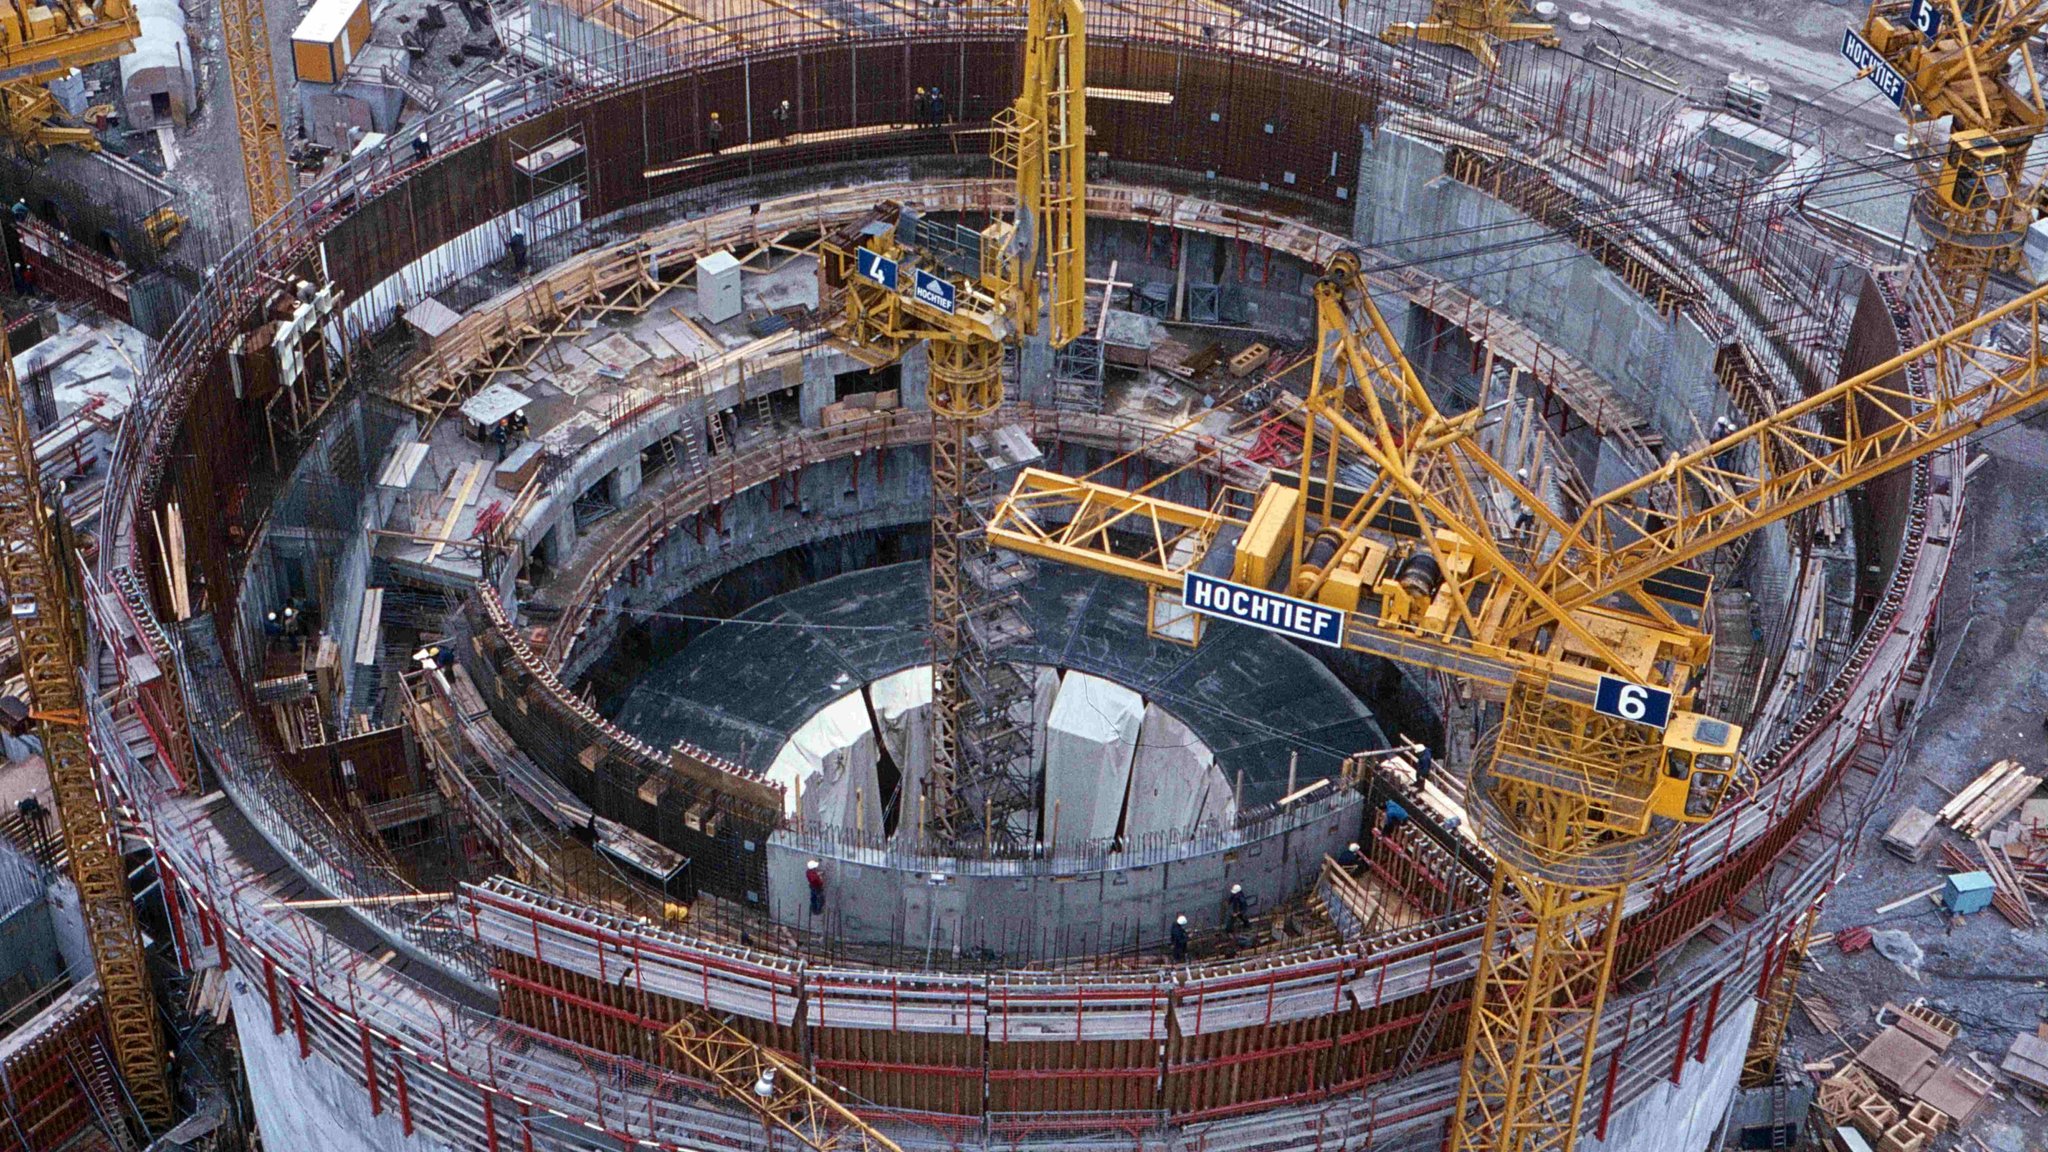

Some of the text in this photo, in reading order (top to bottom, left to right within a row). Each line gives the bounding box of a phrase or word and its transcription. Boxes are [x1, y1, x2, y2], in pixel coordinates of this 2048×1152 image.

[1918, 0, 1932, 32] 5
[870, 256, 885, 284] 4
[917, 287, 952, 309] HOCHTIEF
[1194, 581, 1332, 635] HOCHTIEF
[1618, 685, 1648, 720] 6
